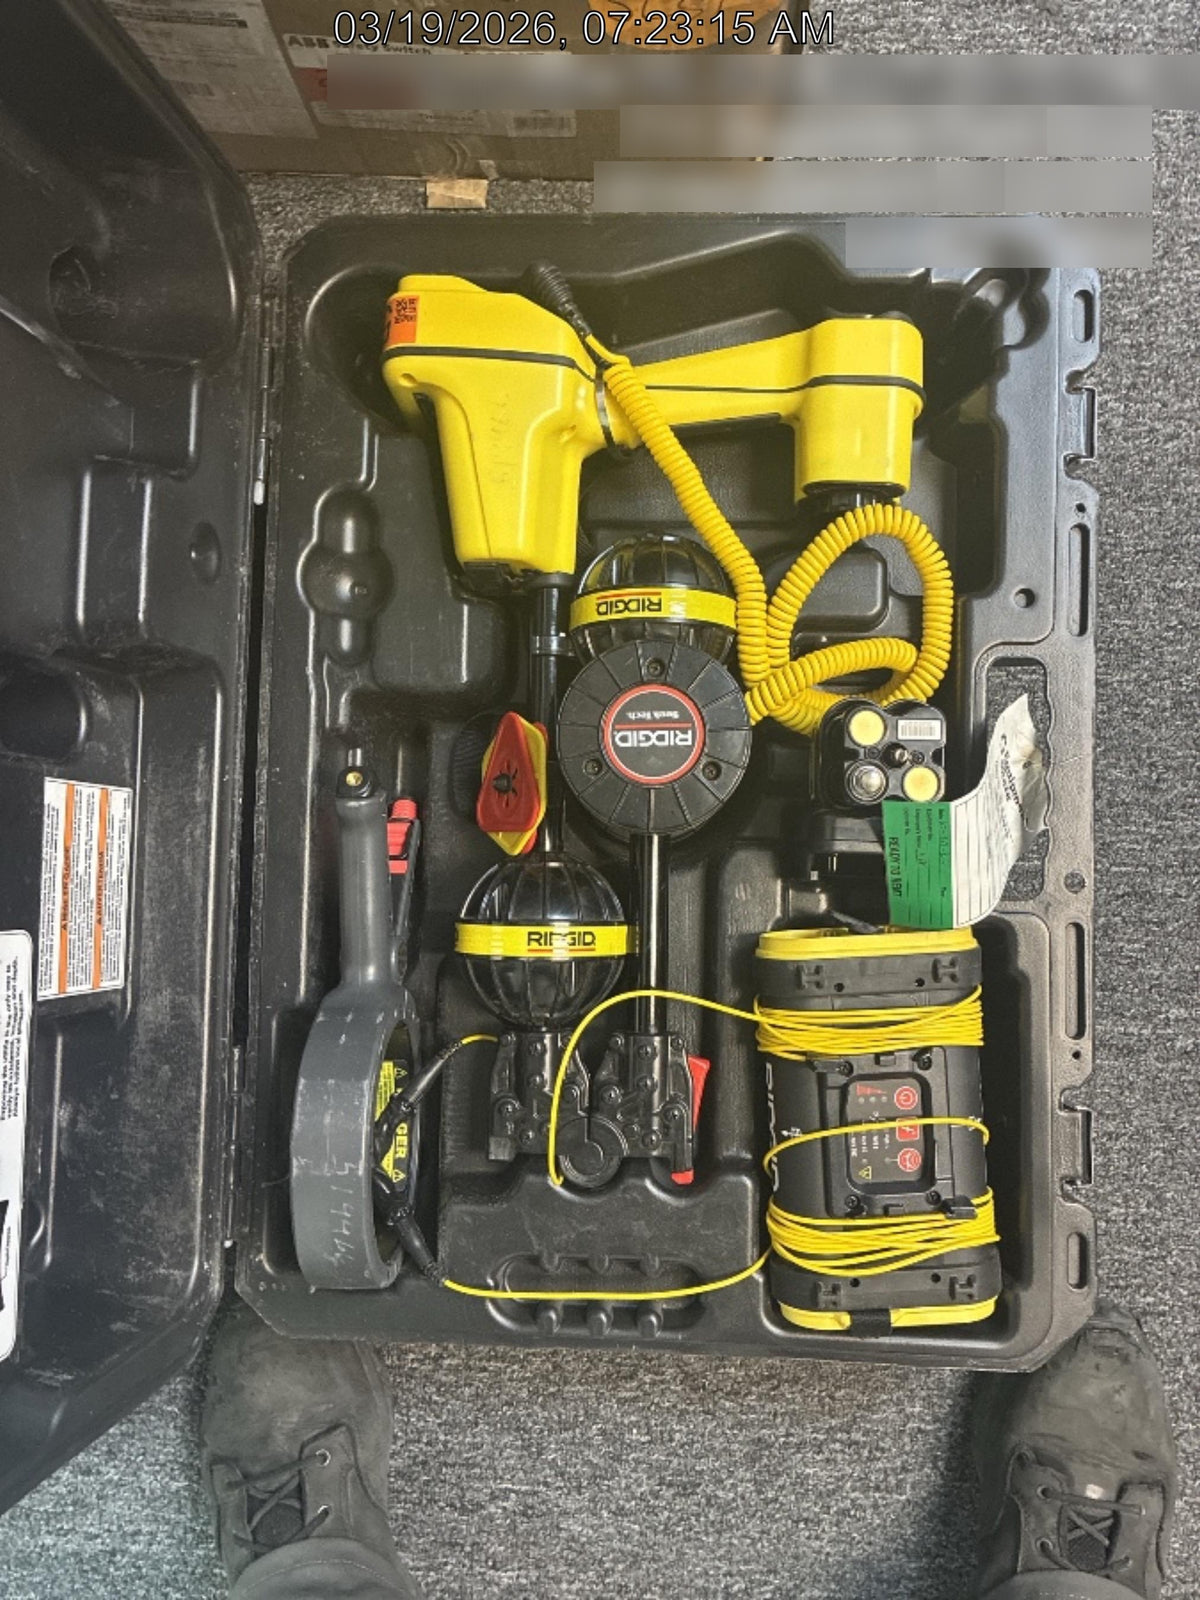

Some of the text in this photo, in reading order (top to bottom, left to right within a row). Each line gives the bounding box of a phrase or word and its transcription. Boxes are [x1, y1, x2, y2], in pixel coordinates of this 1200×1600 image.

[288, 36, 329, 48] ABB
[595, 598, 661, 616] RIDGID
[613, 730, 692, 748] RIDGID
[527, 932, 596, 947] RIDGID
